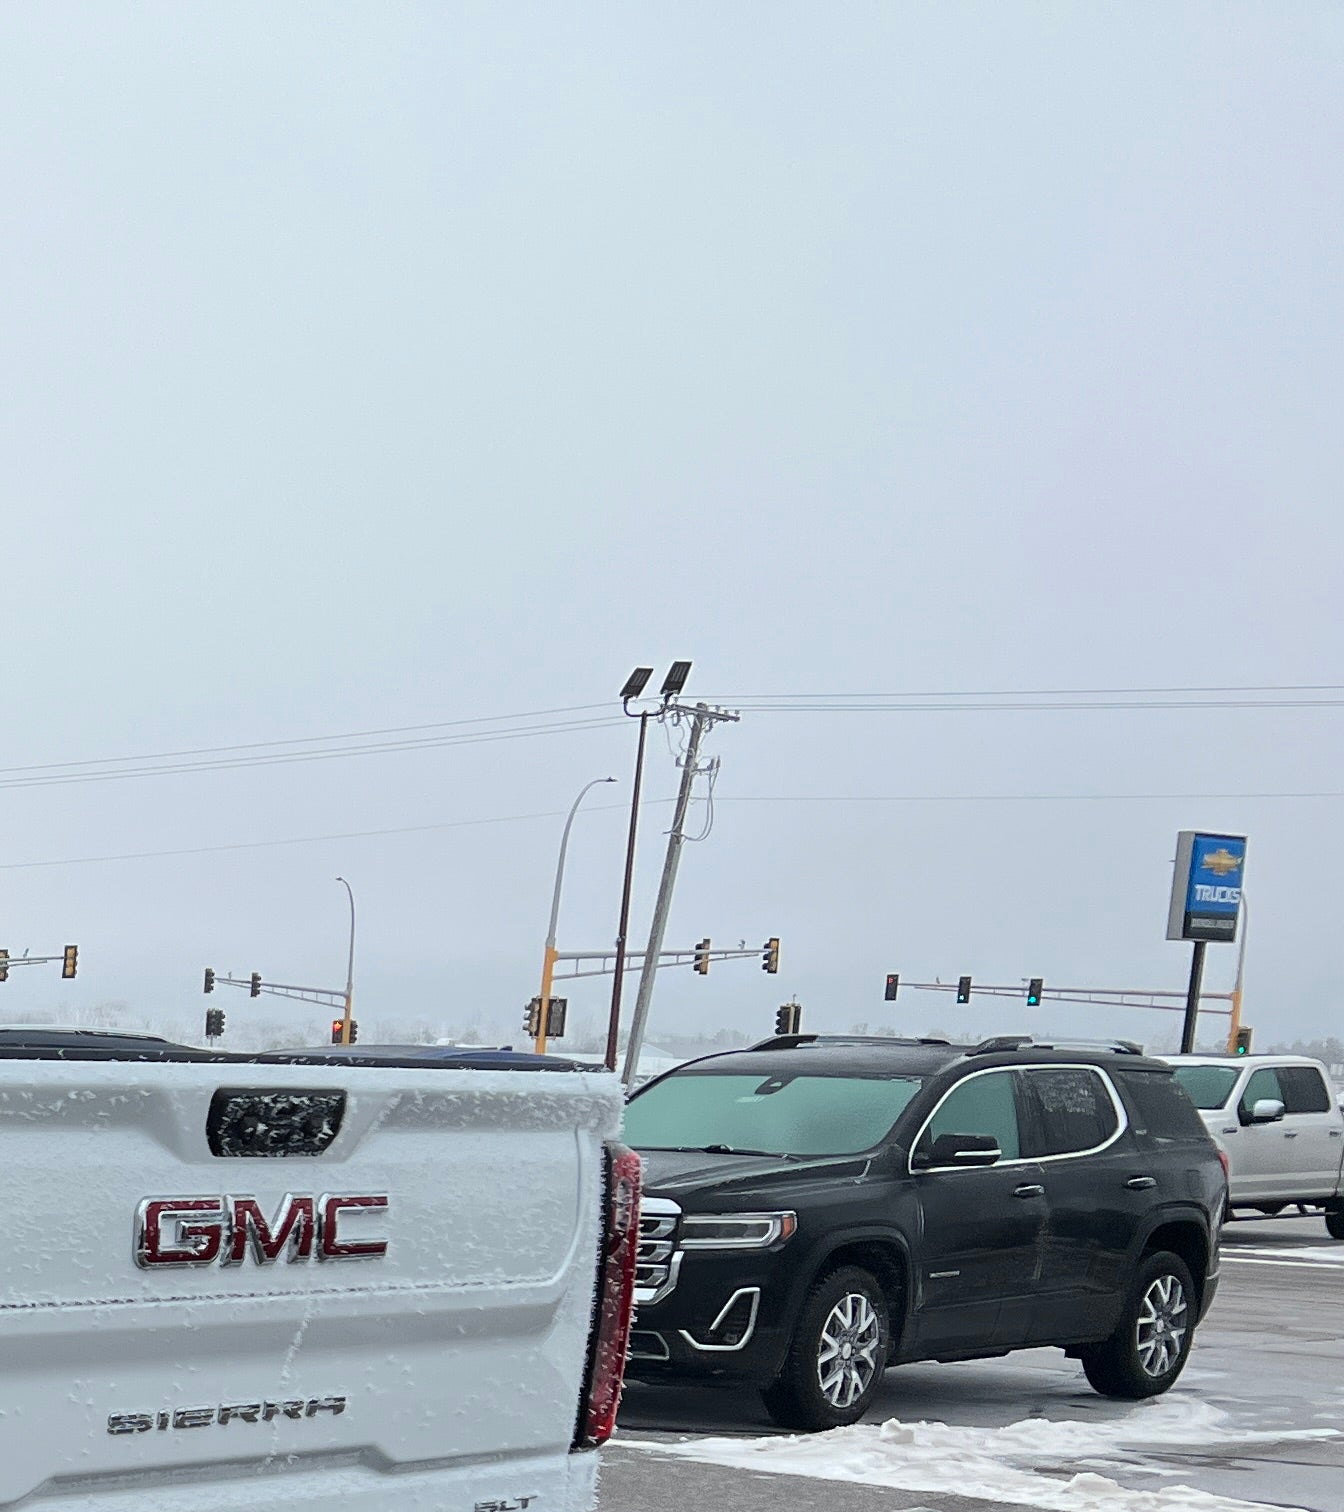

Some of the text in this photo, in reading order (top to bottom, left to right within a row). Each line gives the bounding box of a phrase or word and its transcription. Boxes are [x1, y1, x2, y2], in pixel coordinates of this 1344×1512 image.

[1194, 884, 1241, 904] TRUCKS
[133, 1192, 388, 1271] GMC
[107, 1396, 347, 1435] SIERRA
